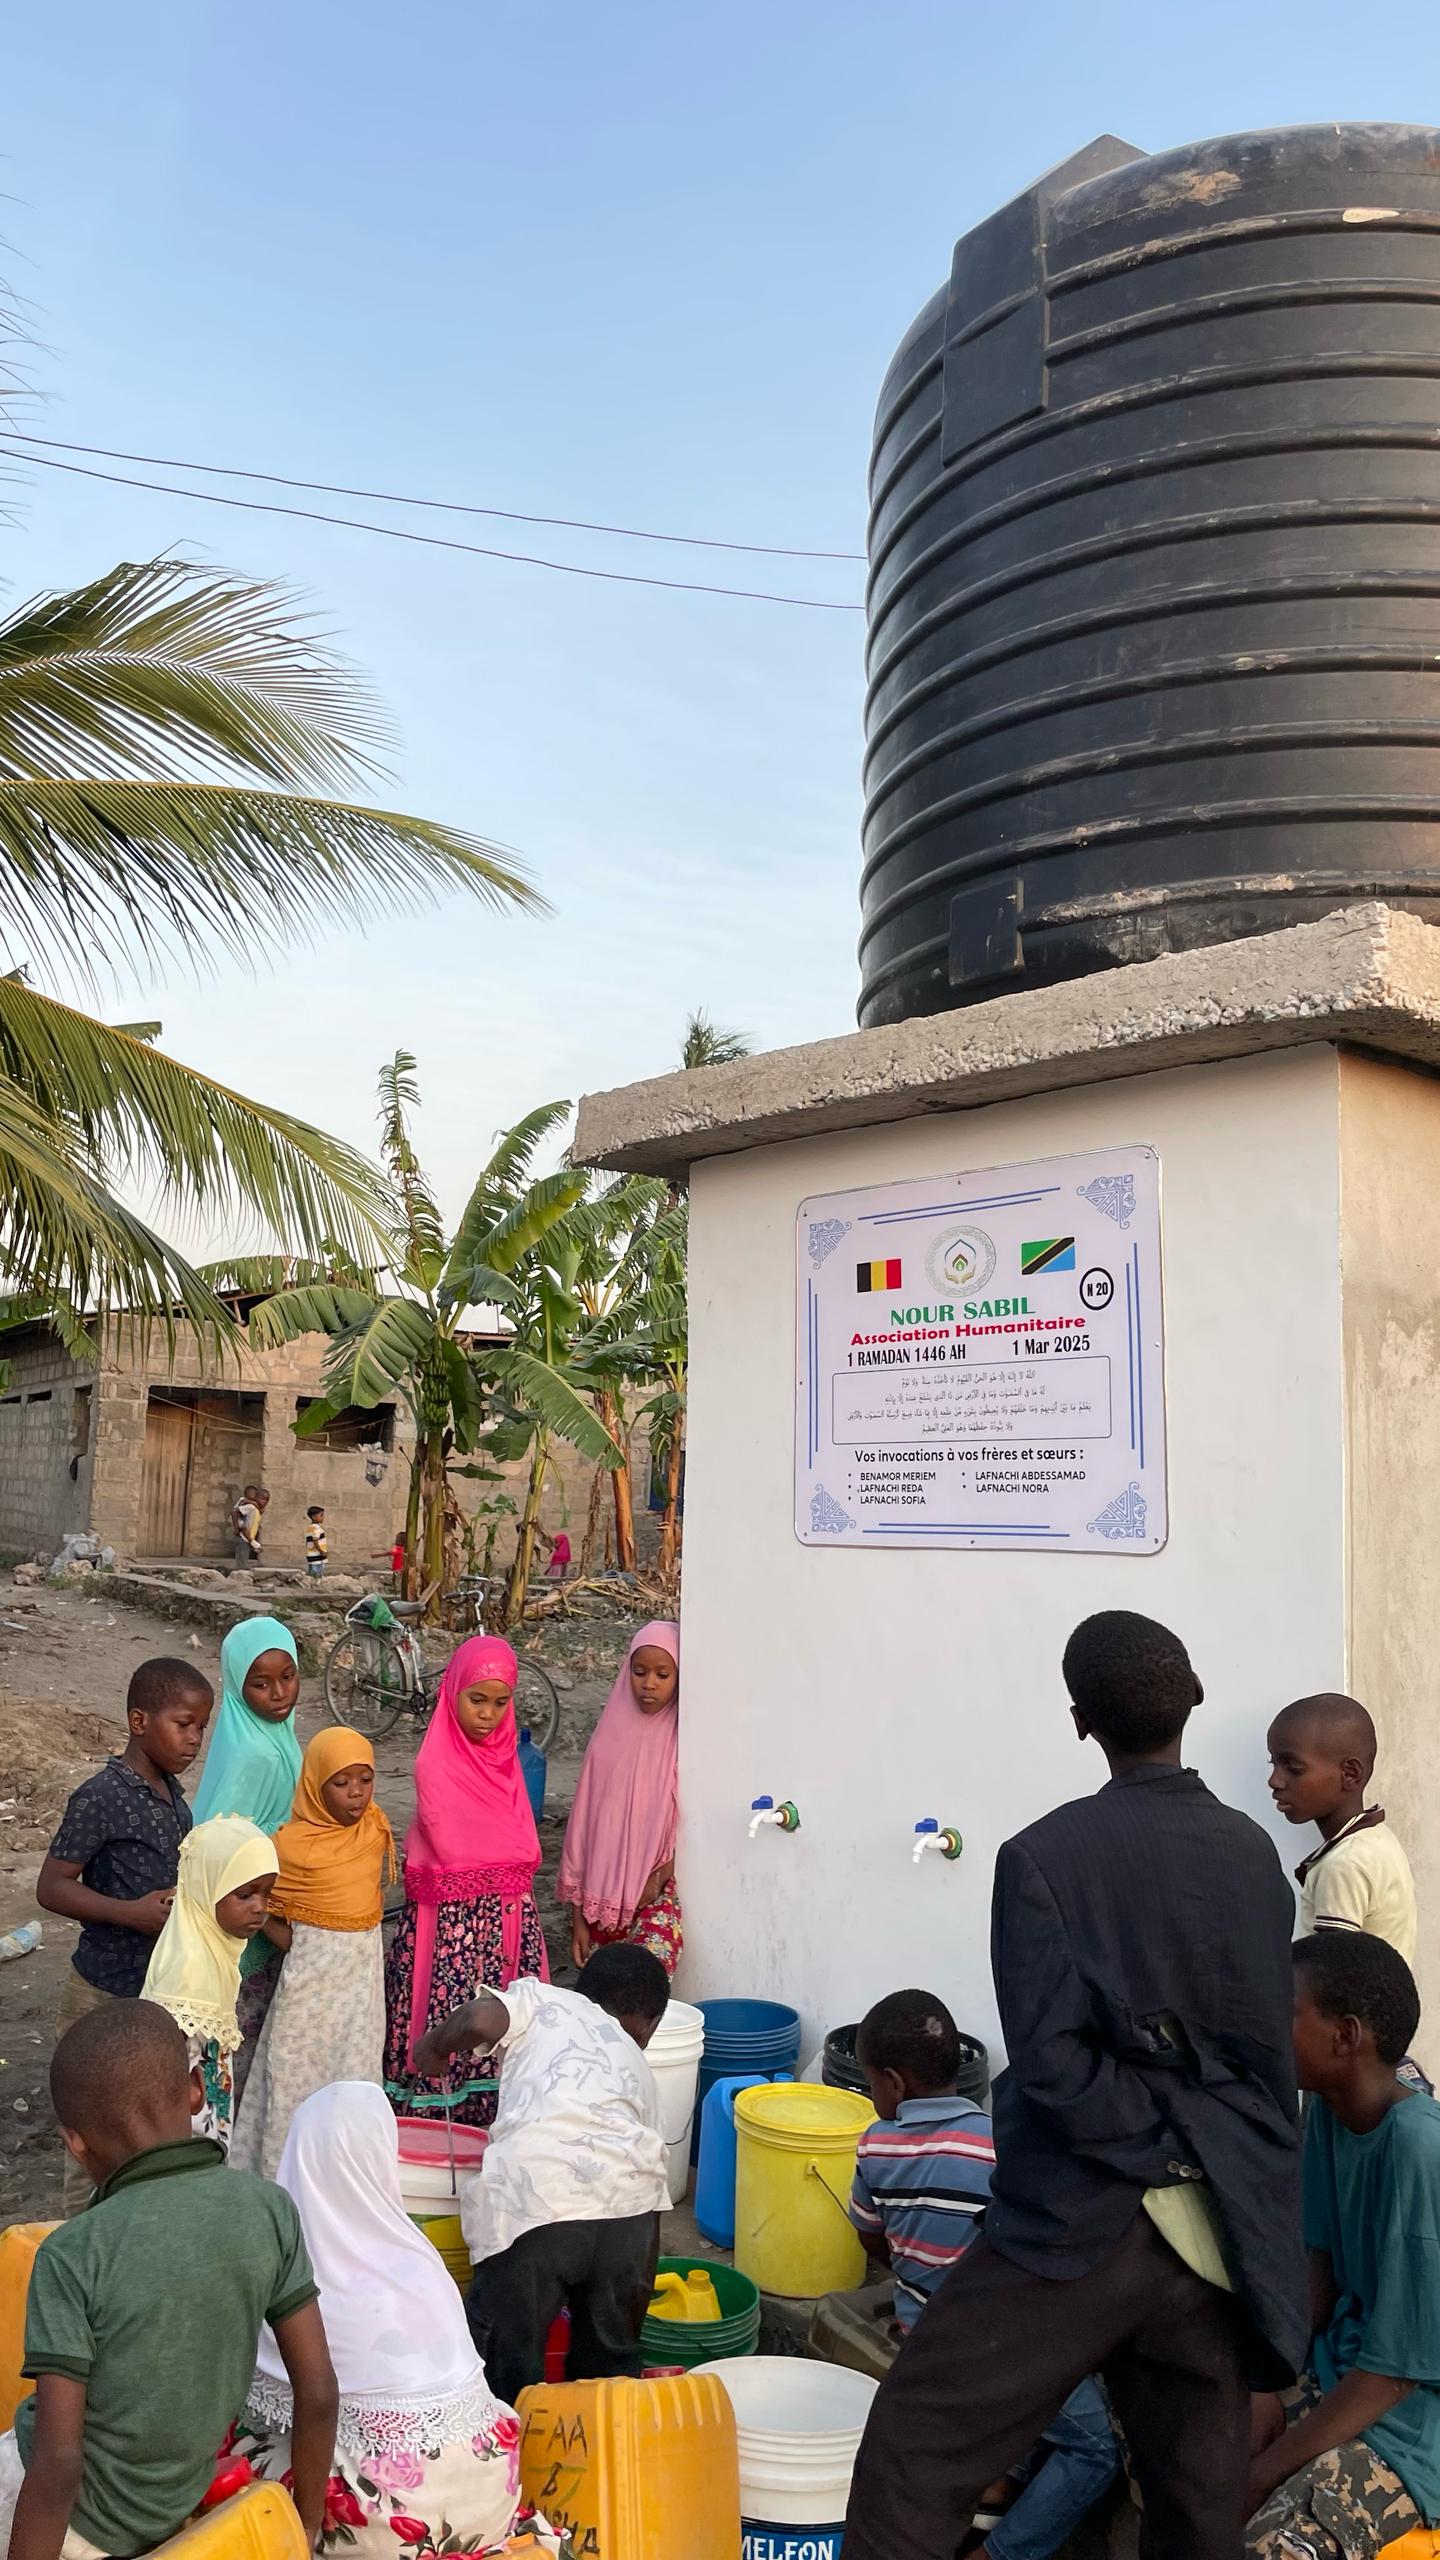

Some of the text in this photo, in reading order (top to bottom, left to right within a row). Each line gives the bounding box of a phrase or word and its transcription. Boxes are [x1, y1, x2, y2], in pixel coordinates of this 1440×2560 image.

[1087, 1281, 1108, 1297] N 20
[890, 1296, 1036, 1327] NOUR SABIL
[850, 1316, 1086, 1346] Association Humanitaire
[1012, 1334, 1091, 1356] 1 Mar 2025
[847, 1344, 967, 1367] 1 RAMADAN 1446 AH
[854, 1449, 876, 1463] Vos
[878, 1448, 944, 1463] invocations
[947, 1447, 955, 1461] à
[958, 1450, 979, 1461] vos
[981, 1447, 1018, 1461] frères
[1021, 1448, 1034, 1460] et
[1036, 1448, 1077, 1460] sœurs
[860, 1471, 936, 1481] BENAMOR MERIEM
[975, 1470, 1086, 1481] LAFNACHI ABDESSAMAD
[901, 1483, 924, 1493] REDA
[976, 1483, 1050, 1493] LAFNACHI NORA
[860, 1495, 926, 1505] LAFNACHI SOFIA
